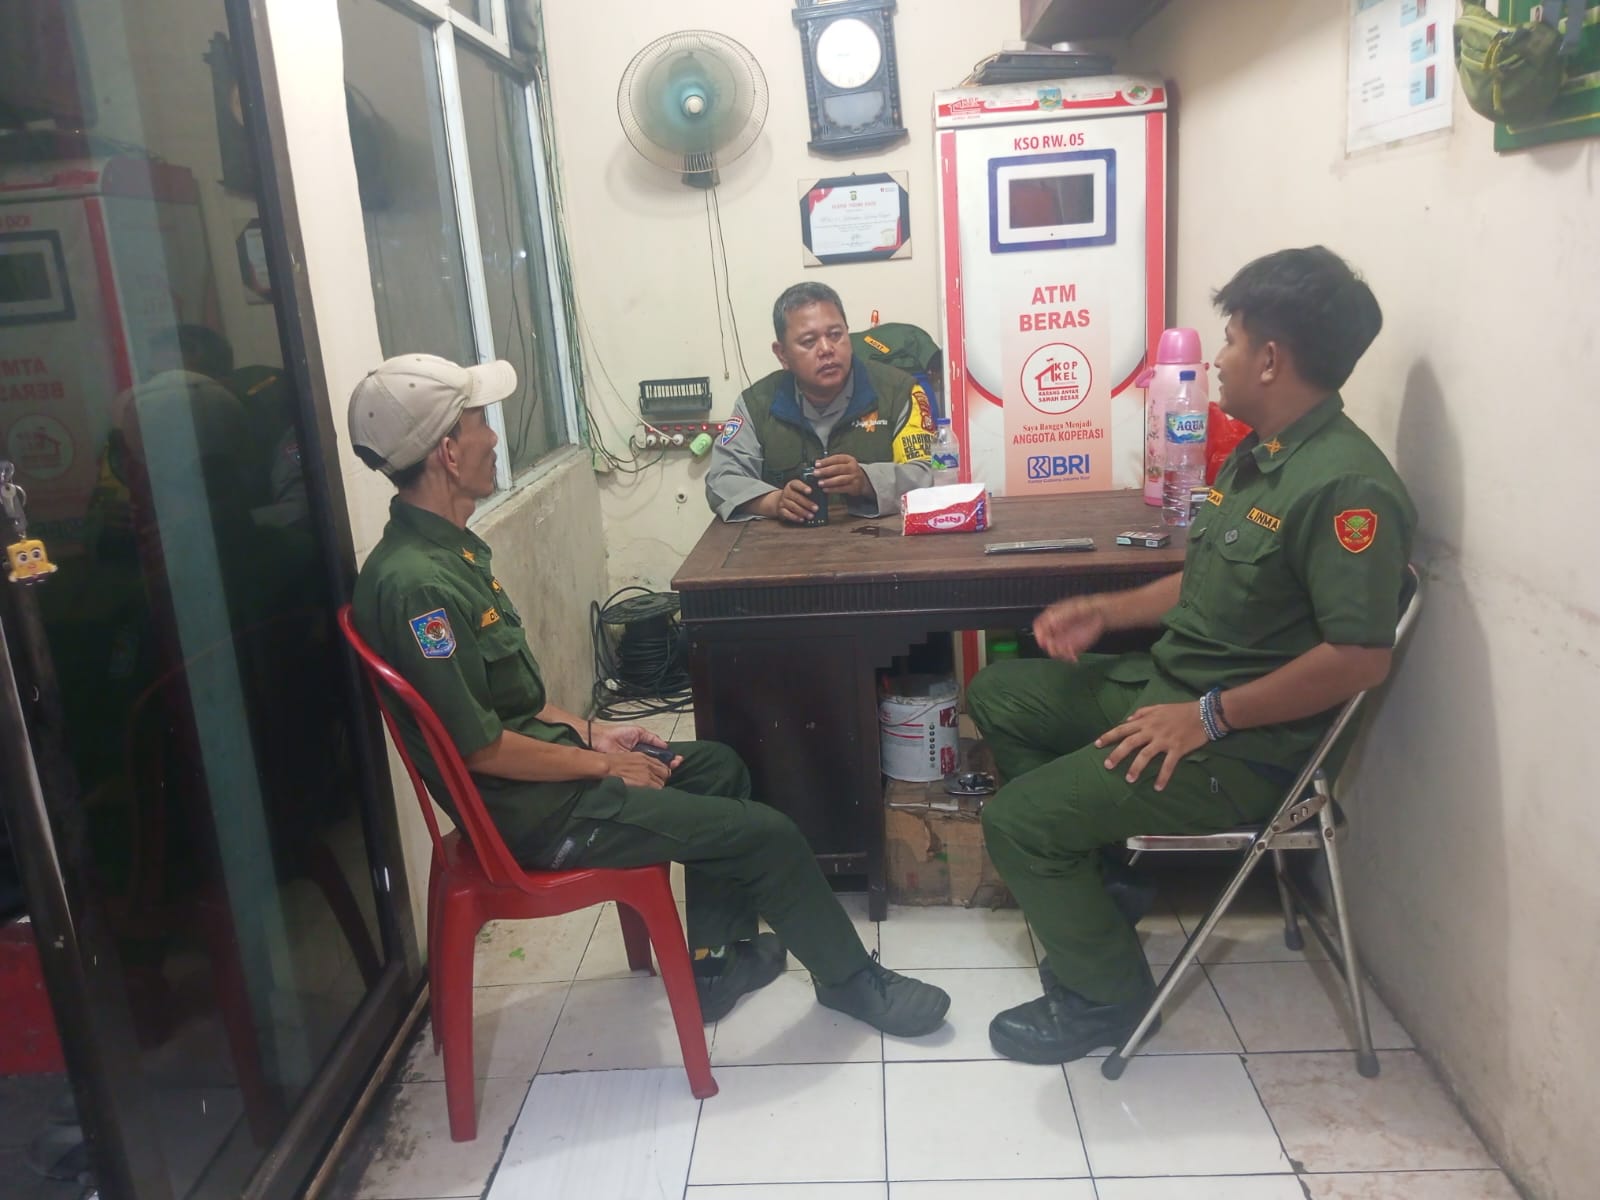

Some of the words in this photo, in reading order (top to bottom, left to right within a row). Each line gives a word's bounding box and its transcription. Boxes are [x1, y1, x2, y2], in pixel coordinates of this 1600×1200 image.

[1014, 136, 1039, 150] KSO
[1042, 134, 1067, 148] RW.
[1069, 132, 1085, 146] 05
[1031, 284, 1076, 305] ATM
[1019, 309, 1090, 332] BERAS
[1054, 361, 1078, 371] KOP
[1054, 372, 1078, 381] KEL
[1023, 424, 1038, 432] Saya
[1065, 419, 1092, 428] Menjadi
[1176, 420, 1204, 432] AQUA
[1013, 432, 1056, 445] ANGGOTA
[1058, 428, 1104, 441] KOPERASI
[1052, 454, 1090, 476] BRI
